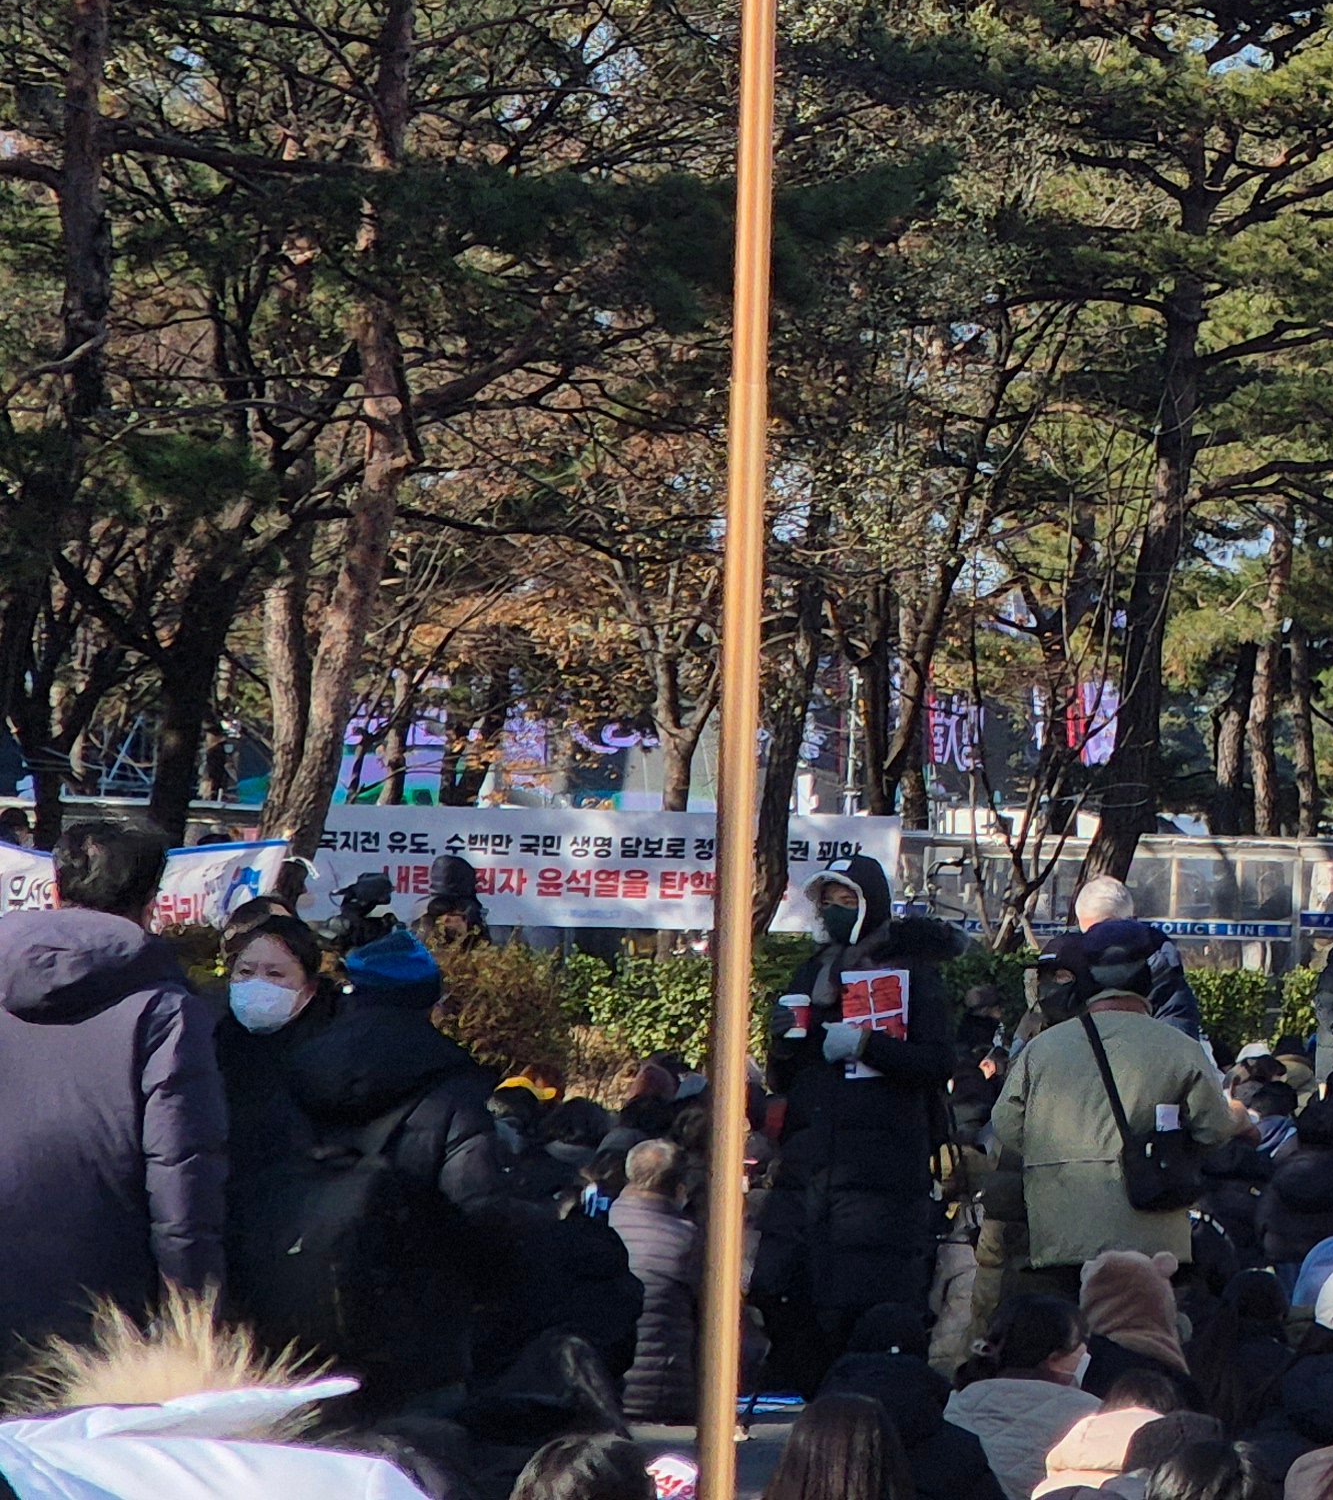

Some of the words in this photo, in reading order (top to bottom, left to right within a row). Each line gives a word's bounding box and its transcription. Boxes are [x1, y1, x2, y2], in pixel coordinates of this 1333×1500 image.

[387, 831, 436, 856] 유도,
[444, 833, 512, 856] 수백만
[519, 834, 562, 857] 국민
[569, 836, 613, 859] 생명
[620, 837, 686, 860] 담보로
[536, 869, 649, 900] 윤석열을
[659, 870, 719, 901] 탄핵
[1227, 923, 1267, 937] LINE
